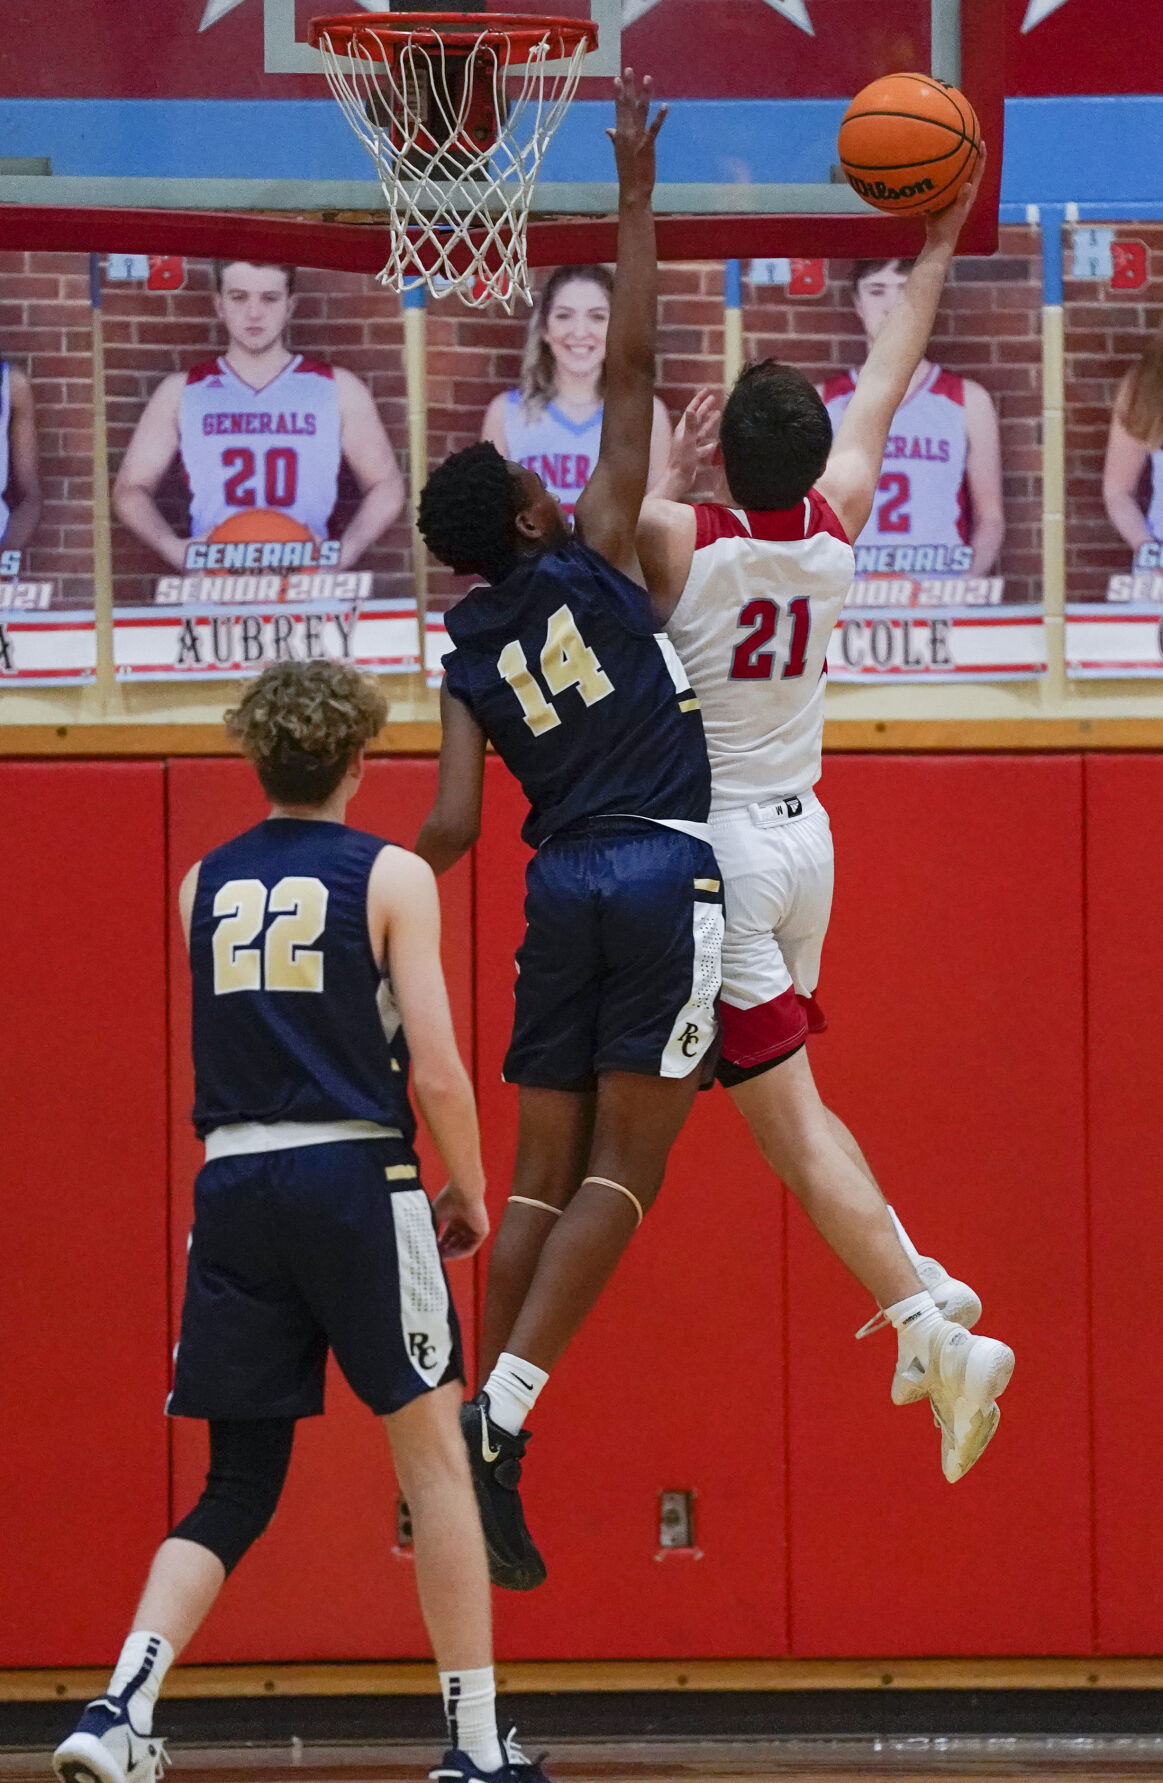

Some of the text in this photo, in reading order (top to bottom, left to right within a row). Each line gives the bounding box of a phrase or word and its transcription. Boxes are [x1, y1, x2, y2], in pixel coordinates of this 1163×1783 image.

[847, 170, 935, 200] Wilson
[202, 411, 317, 436] GENERALS
[883, 435, 951, 462] ERALS
[221, 446, 299, 507] 20
[519, 453, 590, 489] ENER
[876, 471, 912, 534] 2
[185, 540, 341, 569] GENERALS
[856, 545, 974, 573] NERALS
[155, 572, 374, 605] SENIOR 2021
[845, 576, 1004, 606] IOR 2021
[177, 604, 361, 665] AUBREY
[728, 596, 811, 681] 21
[842, 618, 951, 667] COLE
[497, 604, 615, 737] 14
[212, 876, 329, 996] 22
